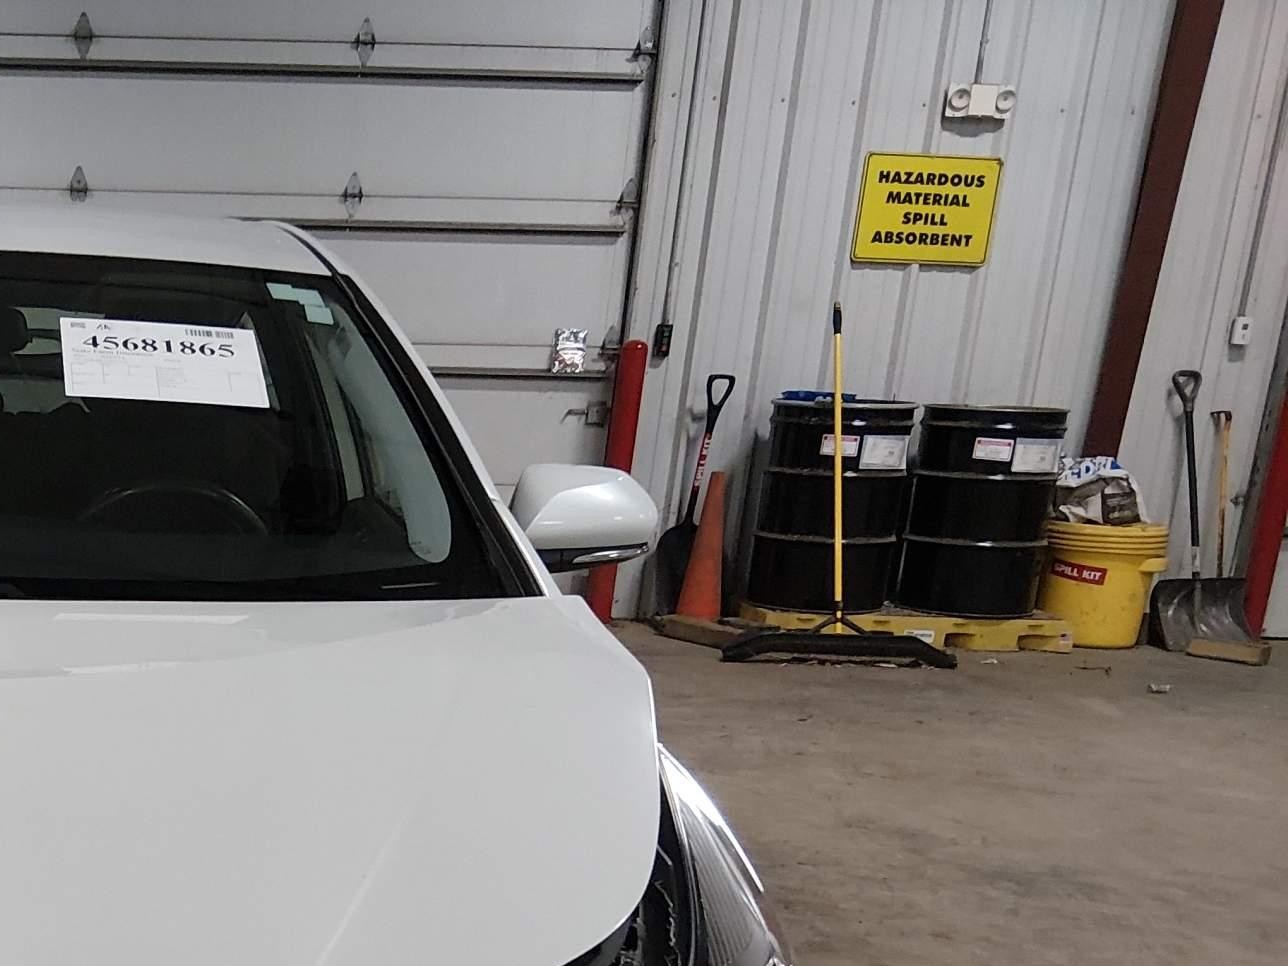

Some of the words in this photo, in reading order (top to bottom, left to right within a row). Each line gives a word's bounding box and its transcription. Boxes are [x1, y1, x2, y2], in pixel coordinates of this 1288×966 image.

[878, 170, 986, 188] HAZARDOUS
[885, 191, 970, 208] MATERIAL
[901, 211, 948, 227] SPILL
[870, 230, 973, 248] ABSORBENT
[82, 334, 236, 359] 45681865
[1053, 562, 1080, 577] SPILL
[1081, 568, 1103, 581] KIT
